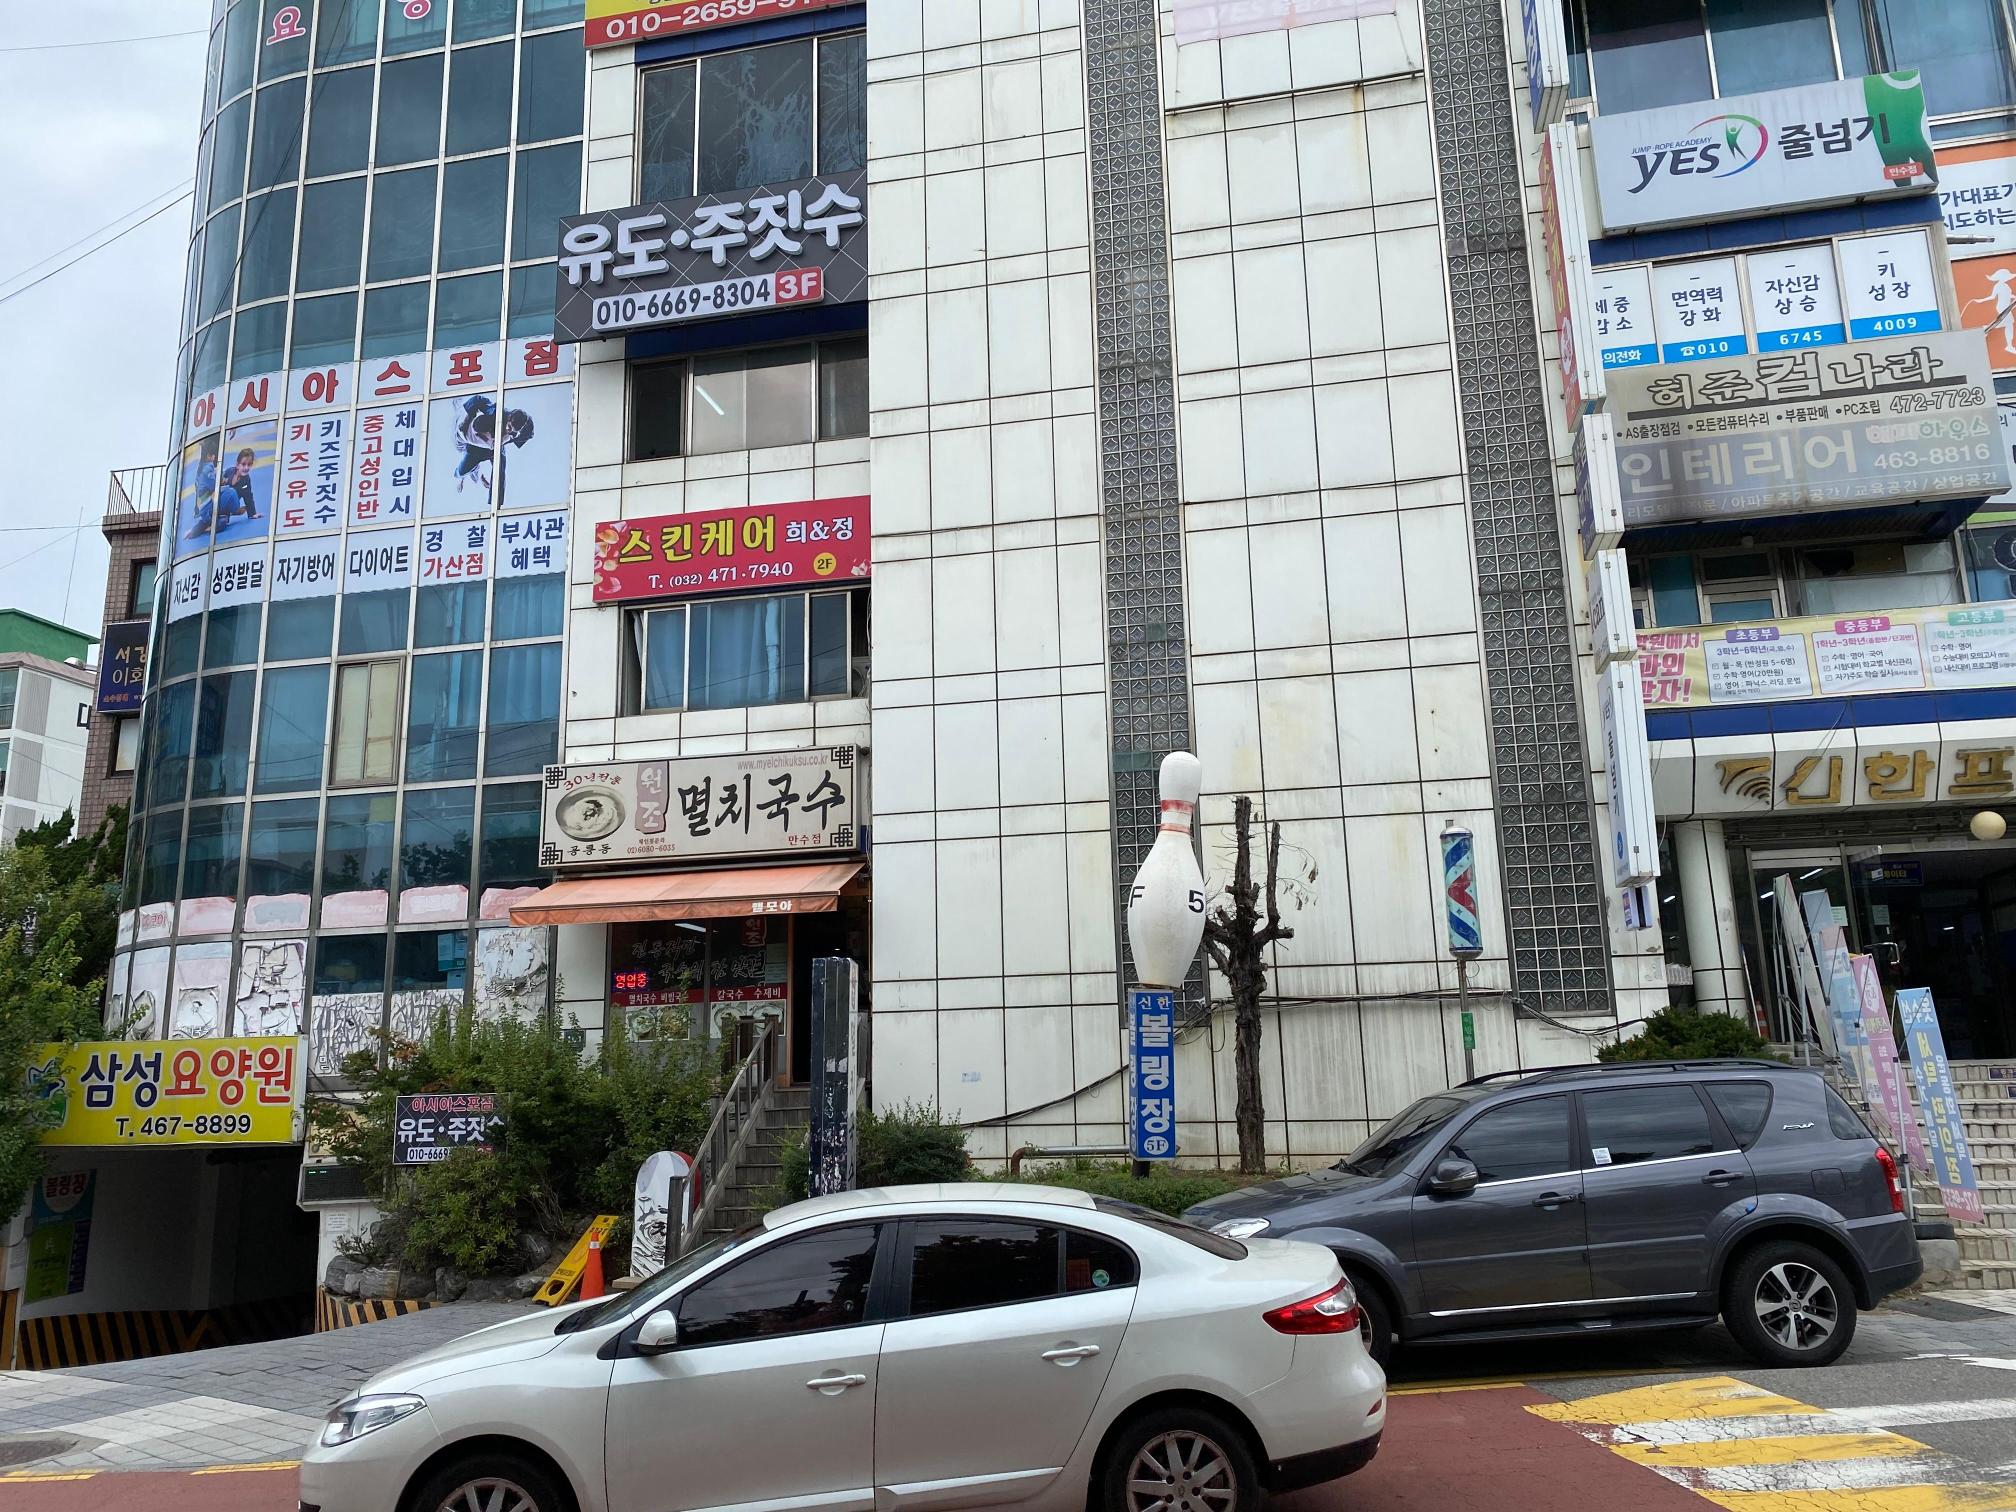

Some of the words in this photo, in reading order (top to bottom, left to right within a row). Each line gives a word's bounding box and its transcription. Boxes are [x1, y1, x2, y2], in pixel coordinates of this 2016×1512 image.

[1675, 136, 1712, 148] ACADEMY
[1778, 112, 1890, 160] 줄넘기
[558, 183, 863, 287] 유도·주짓수
[1877, 263, 1896, 278] 키
[1672, 287, 1723, 307] 면역력
[1765, 274, 1820, 294] 자신감
[1868, 281, 1911, 302] 성장
[596, 278, 770, 325] 010-6669-8304
[778, 271, 817, 299] 3F
[1774, 295, 1817, 315] 상승
[1679, 307, 1721, 327] 강화
[1697, 341, 1728, 355] 010
[1779, 330, 1822, 345] 6745
[1873, 317, 1917, 332] 4009
[1625, 421, 1681, 439] AS출장점검
[1695, 411, 1769, 432] 모든컴퓨터수리
[1785, 405, 1829, 425] 부품판매
[1844, 399, 1881, 415] PC조립
[1890, 387, 1985, 413] 472-7723
[357, 414, 385, 519] 중고성인반
[389, 410, 416, 515] 체대입시
[1621, 429, 1857, 494] 인테리어
[1874, 443, 1990, 469] 463-8816
[283, 423, 311, 528] 키즈유도
[314, 419, 341, 524] 키즈주짓수
[1855, 479, 1918, 497] 교육공간
[1933, 471, 1998, 489] 상업공간
[501, 517, 565, 543] 부사관
[618, 514, 776, 564] 스킨케어
[784, 516, 854, 544] 희&정
[212, 560, 264, 594] 성장발달
[276, 552, 335, 584] 자기방어
[349, 545, 409, 577] 다이어트
[423, 552, 484, 579] 가산점
[511, 545, 550, 570] 혜택
[648, 574, 664, 589] T.
[669, 573, 703, 588] (032)
[817, 558, 833, 570] 2F
[1736, 628, 1773, 640] 초등부
[1844, 618, 1882, 633] 중등부
[640, 767, 662, 828] 원조
[678, 769, 846, 837] 멸치국수
[788, 833, 821, 846] 만수점
[1188, 889, 1205, 914] 5
[615, 973, 648, 989] 영업중
[628, 992, 657, 1005] 멸치국수
[717, 988, 744, 1001] 칼국수
[753, 986, 781, 999] 수제비
[80, 1046, 293, 1108] 삼성요양원
[1138, 1013, 1173, 1134] 볼링장
[116, 1117, 134, 1137] T.
[140, 1114, 251, 1136] 467-8899
[1146, 1139, 1167, 1152] 5F
[46, 1173, 87, 1198] 볼링장
